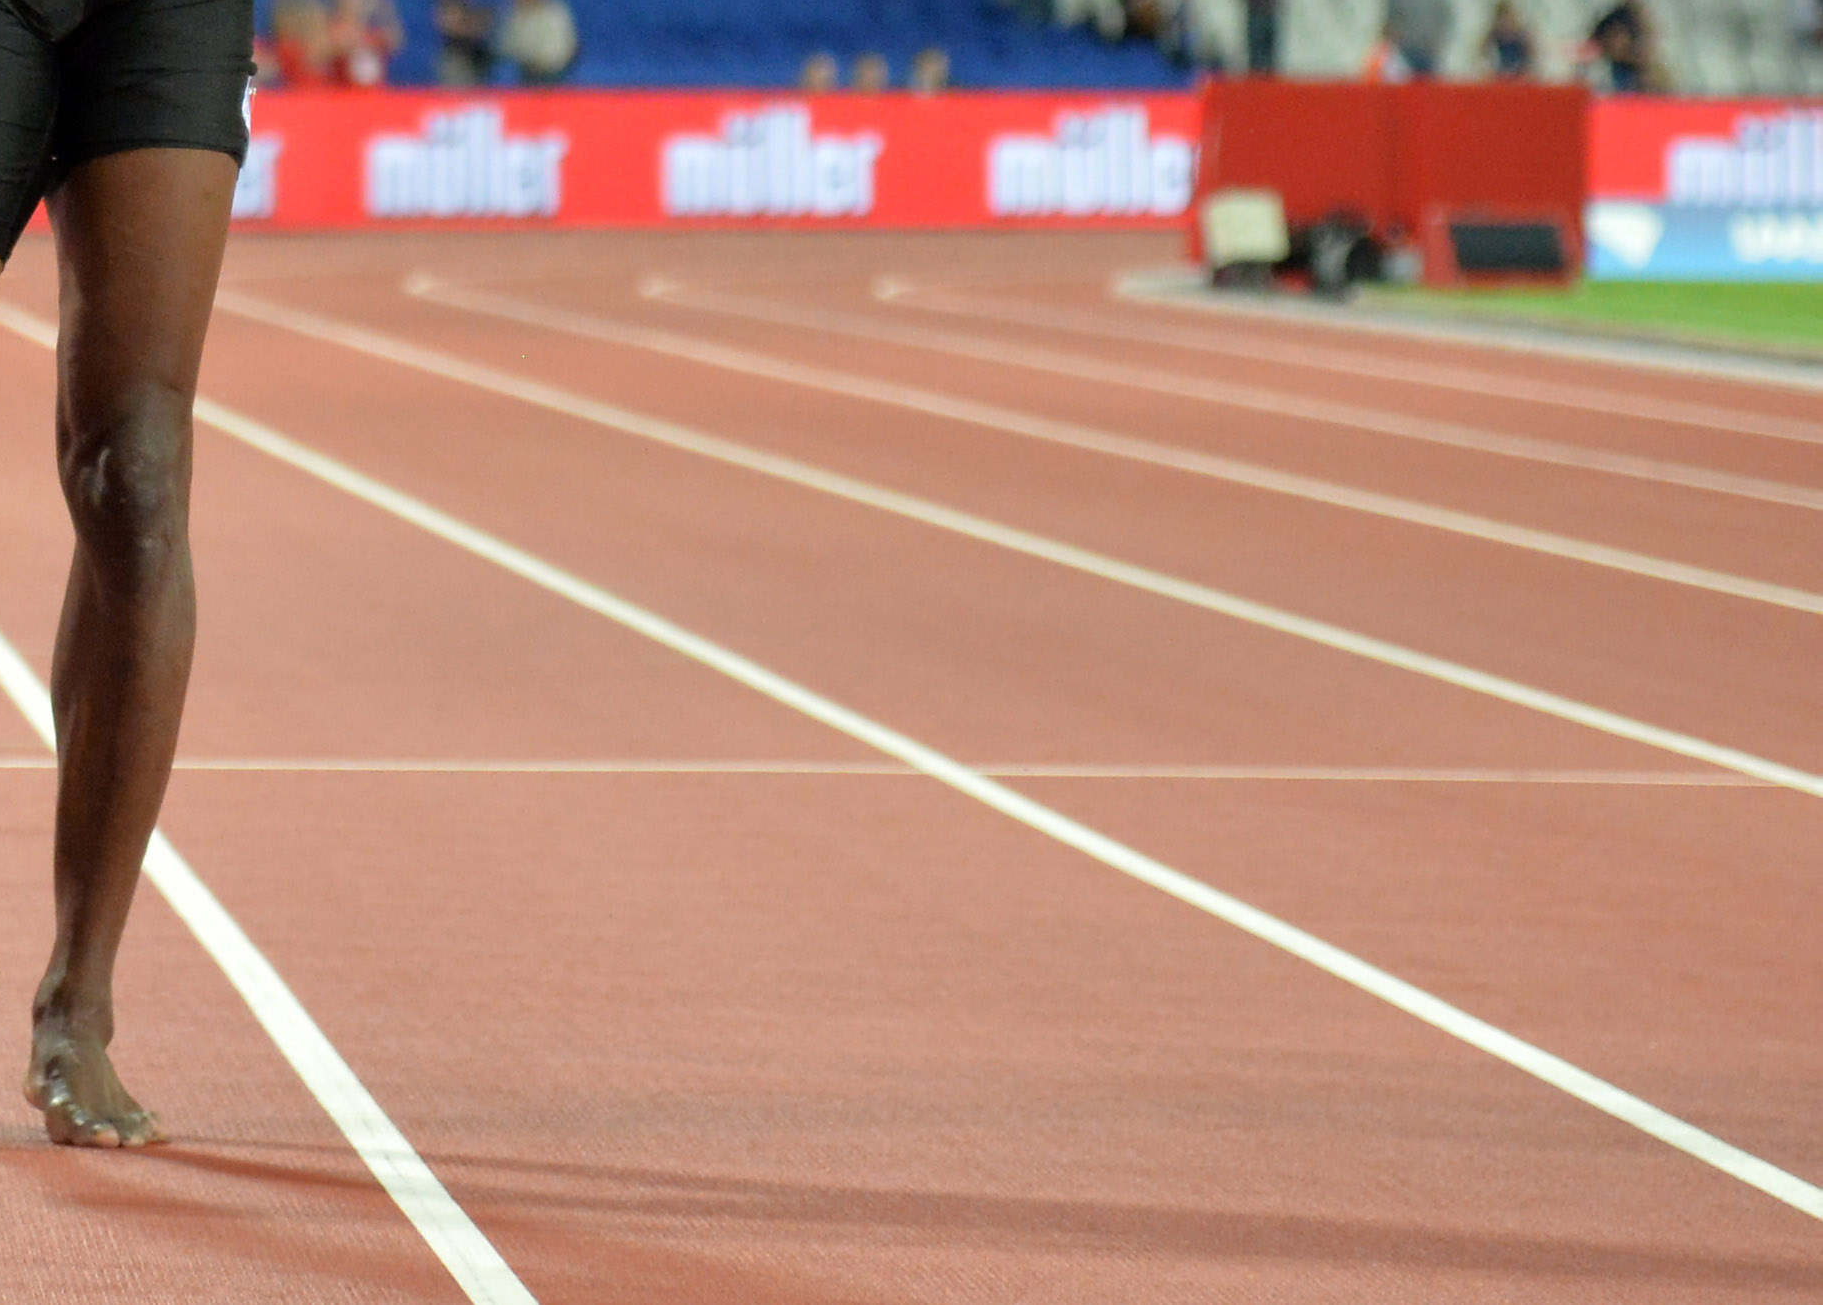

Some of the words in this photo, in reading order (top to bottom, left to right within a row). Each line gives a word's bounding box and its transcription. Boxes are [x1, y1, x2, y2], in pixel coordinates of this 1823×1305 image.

[364, 103, 567, 215] müller
[663, 103, 883, 215] müller
[988, 103, 1195, 215] mülle
